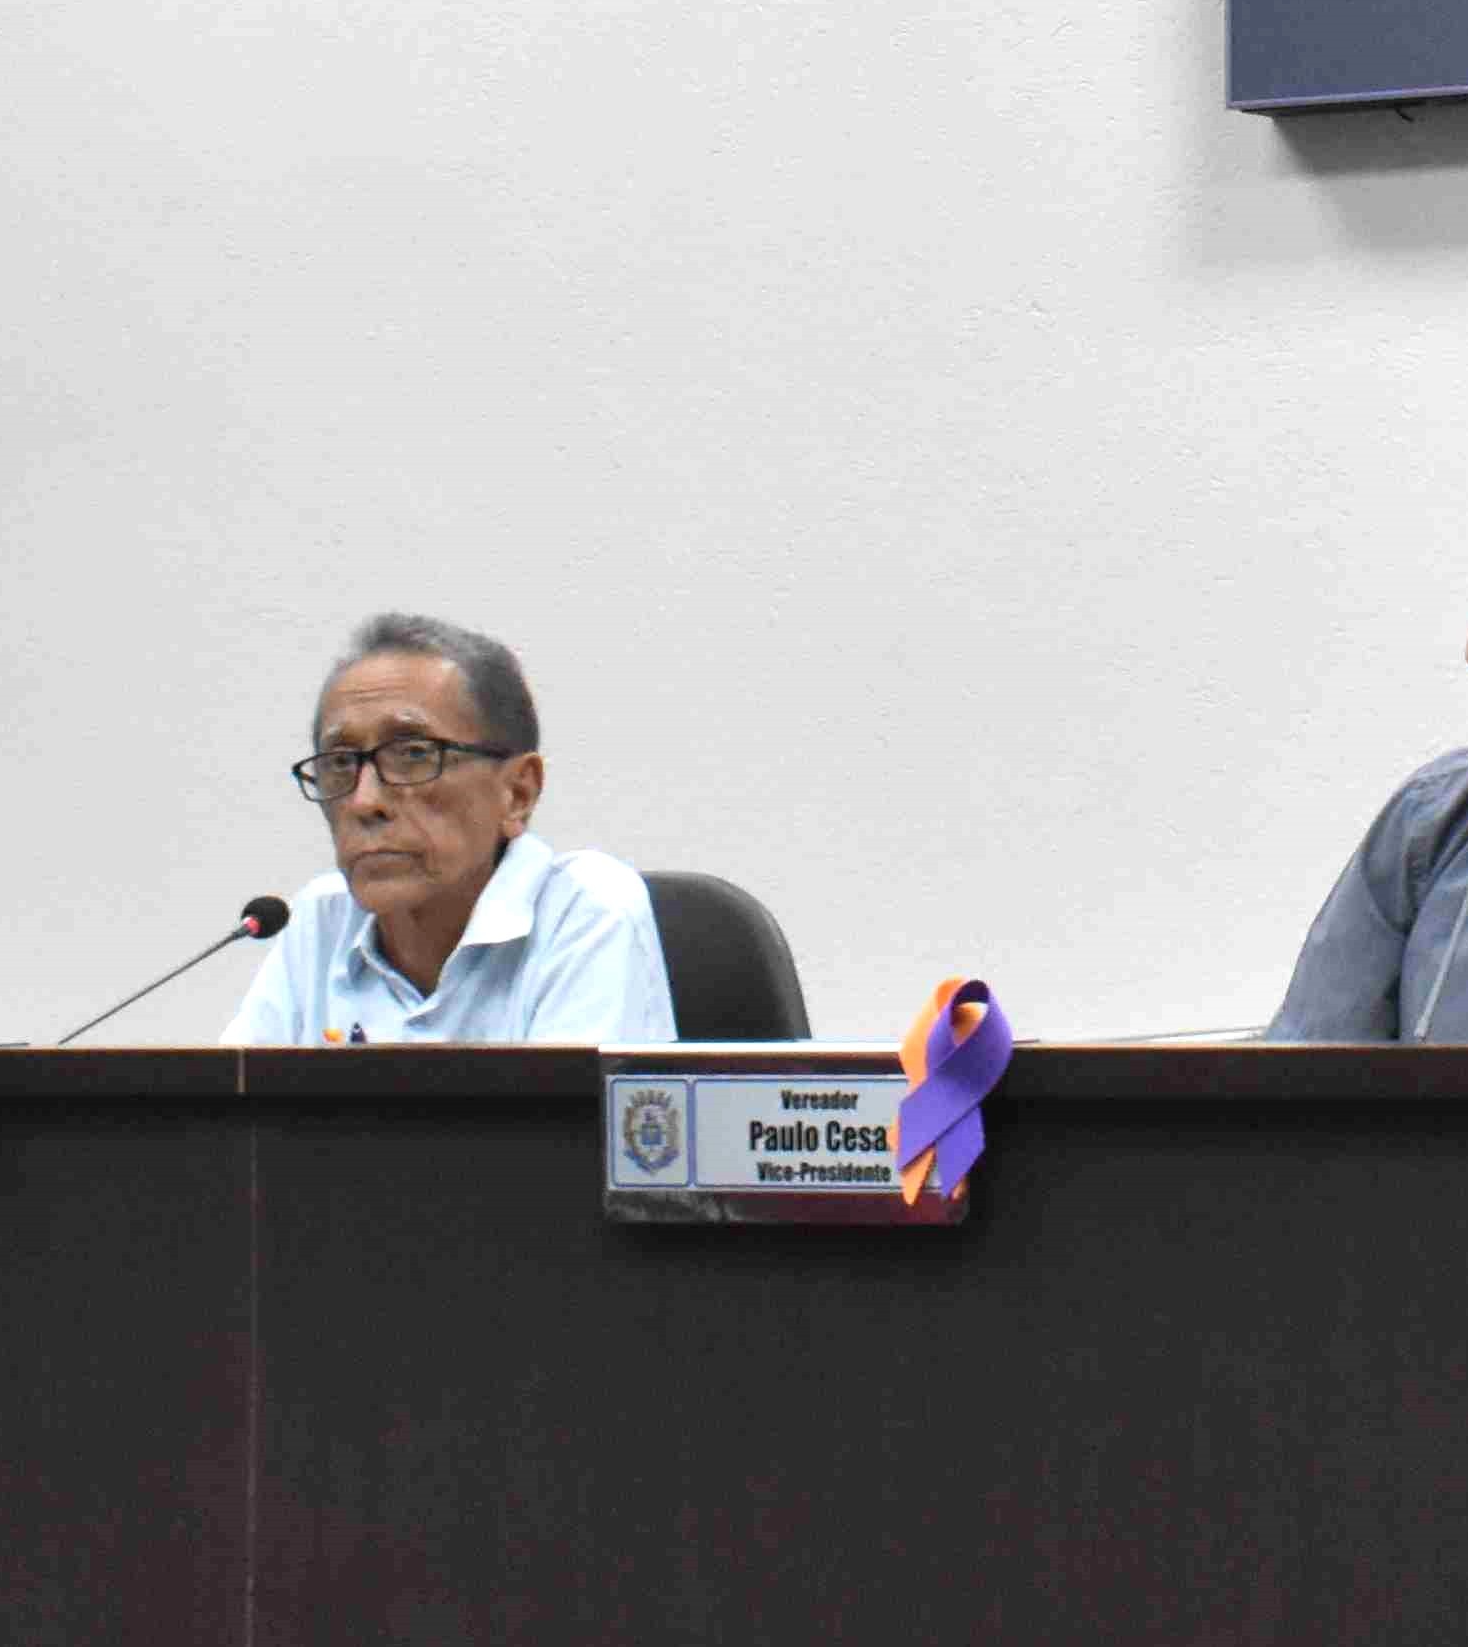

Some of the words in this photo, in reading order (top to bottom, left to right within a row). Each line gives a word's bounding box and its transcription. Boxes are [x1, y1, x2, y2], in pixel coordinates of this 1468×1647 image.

[780, 1089, 859, 1111] Vereador
[749, 1120, 819, 1153] Paulo
[826, 1120, 890, 1153] Cesa
[756, 1160, 892, 1183] Vice-Presidente
